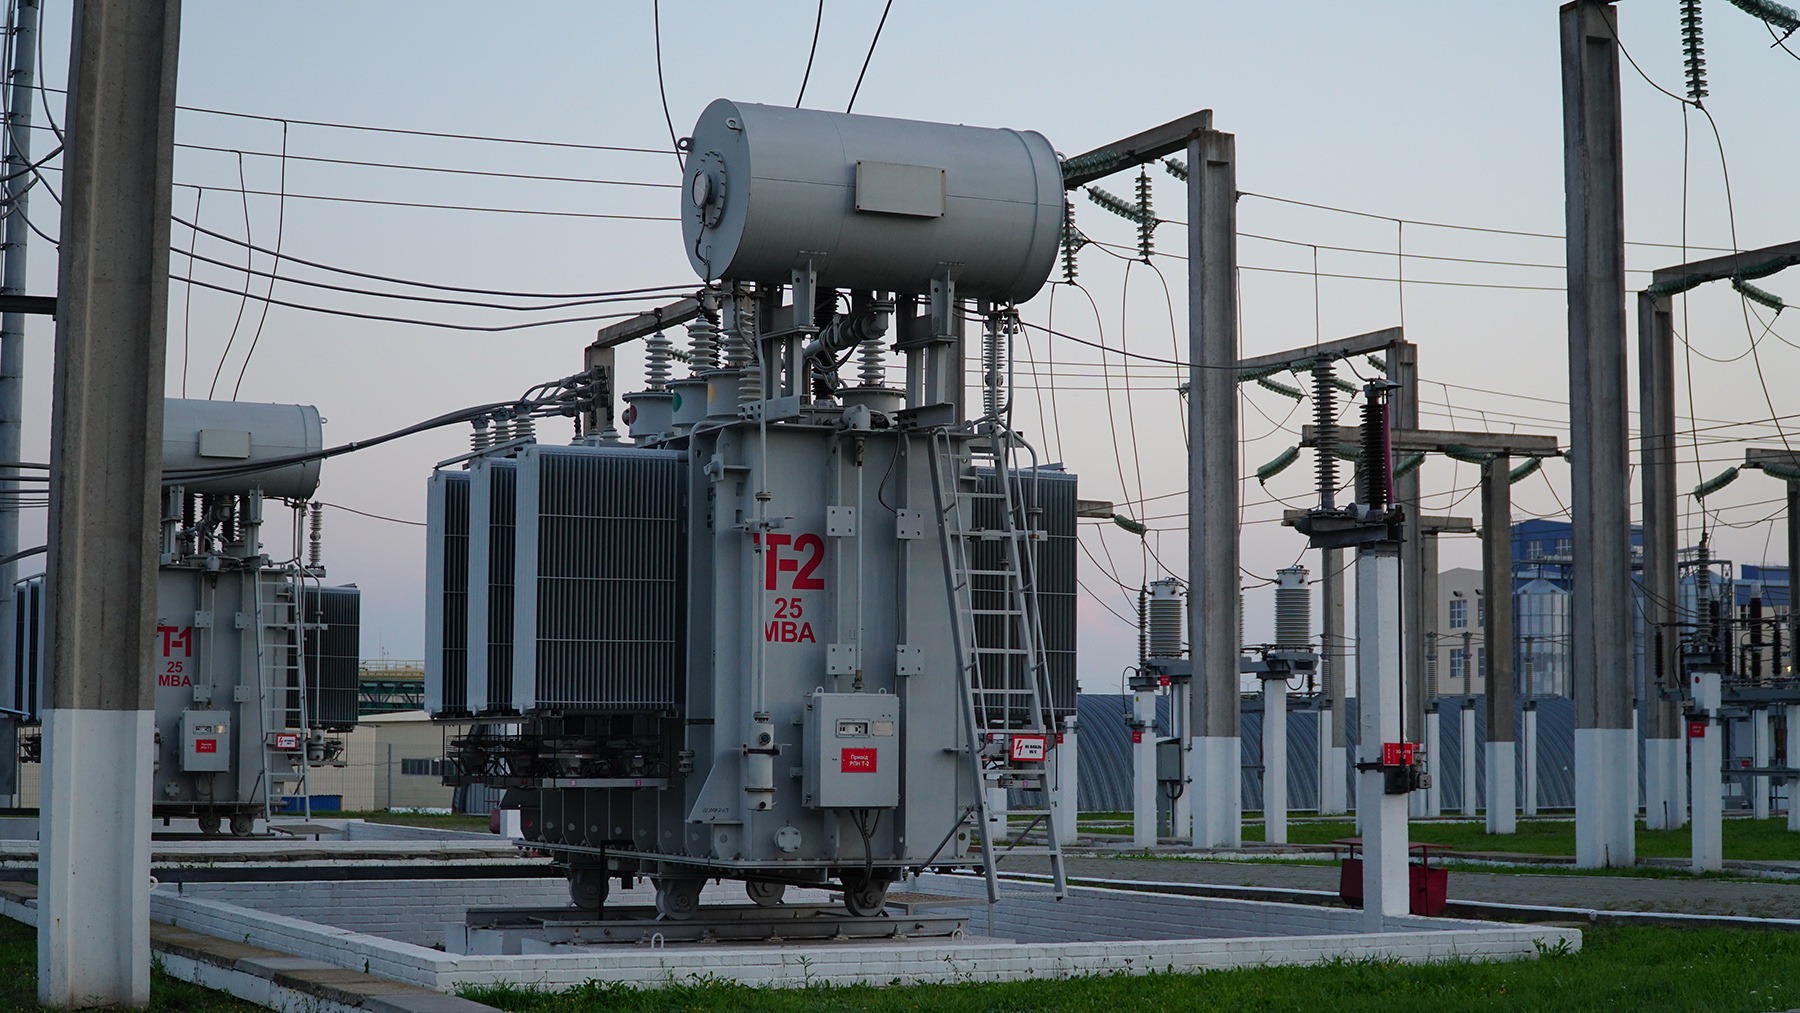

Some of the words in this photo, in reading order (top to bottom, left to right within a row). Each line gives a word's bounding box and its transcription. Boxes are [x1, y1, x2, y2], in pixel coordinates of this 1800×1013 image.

[753, 533, 825, 590] Т-2
[774, 597, 803, 619] 25
[157, 626, 192, 657] Т-1
[167, 661, 183, 673] 25
[158, 675, 192, 687] МВА
